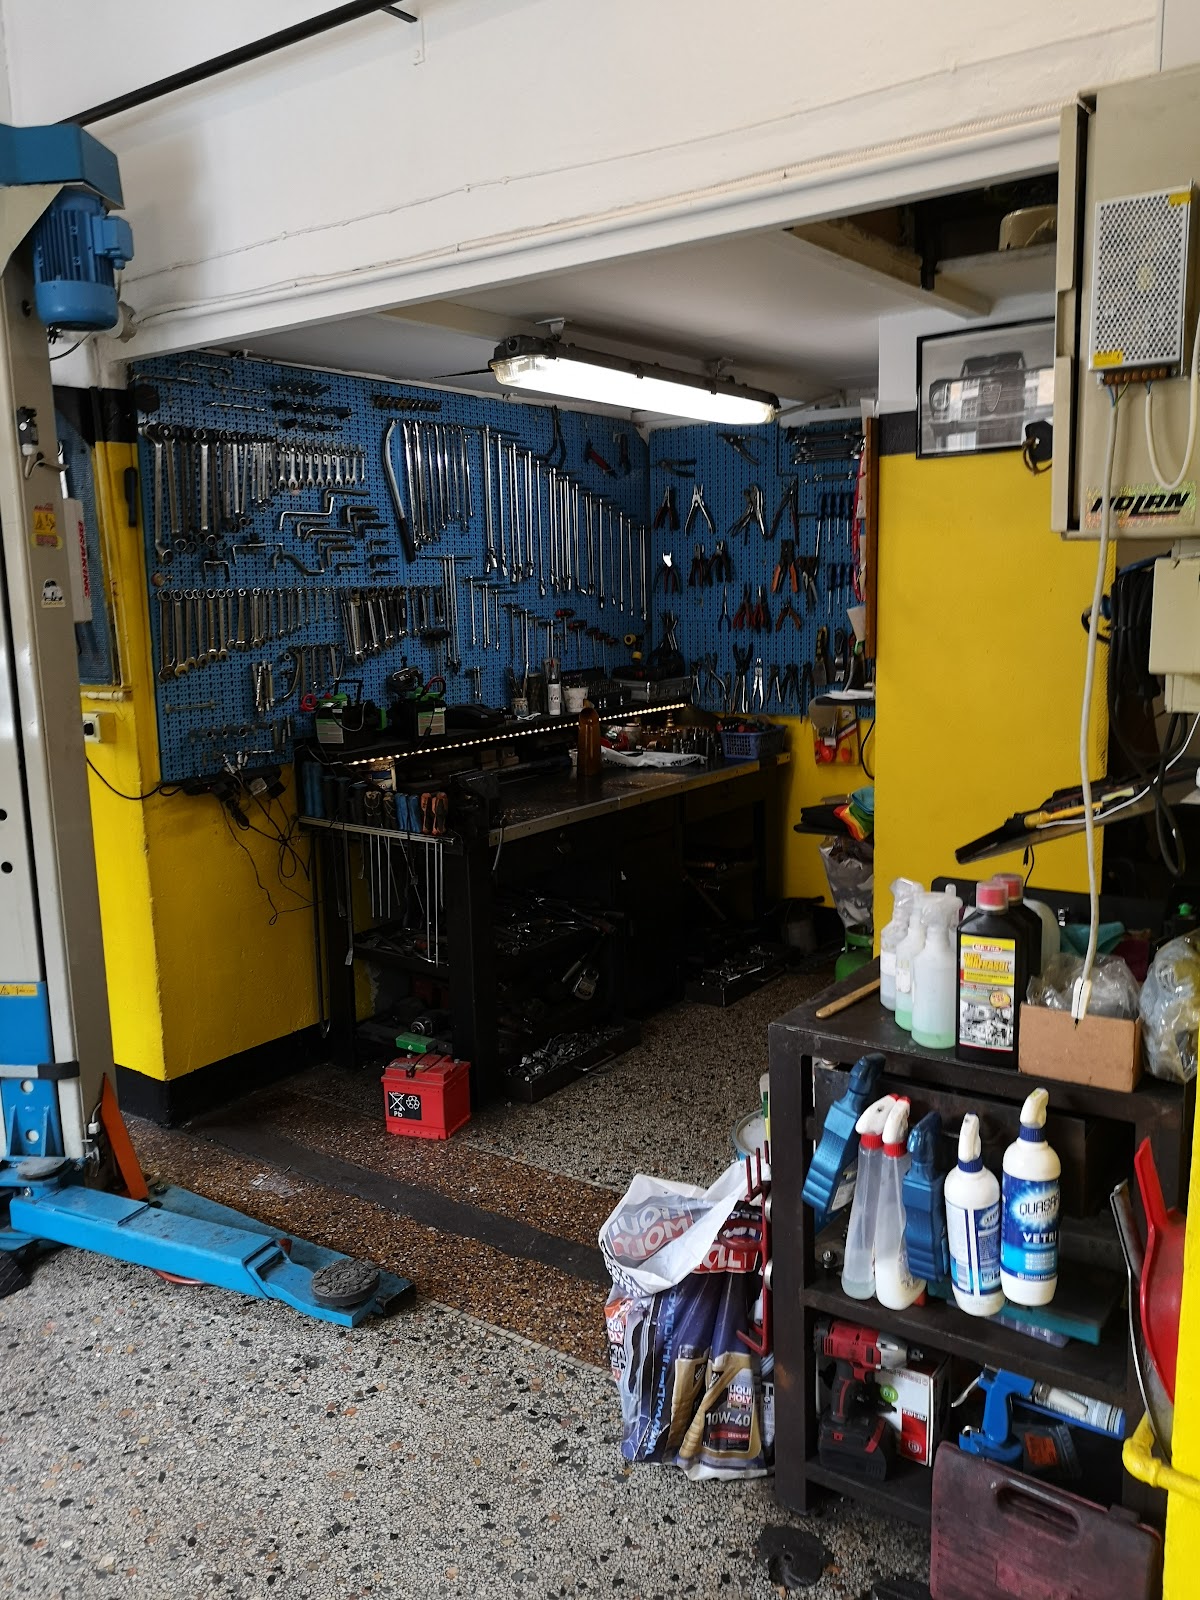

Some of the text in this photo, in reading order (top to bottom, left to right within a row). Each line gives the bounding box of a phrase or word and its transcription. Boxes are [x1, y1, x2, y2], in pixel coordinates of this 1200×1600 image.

[1091, 492, 1190, 516] NOLAN
[729, 1394, 752, 1404] MOLY
[706, 1411, 750, 1427] 10W-40
